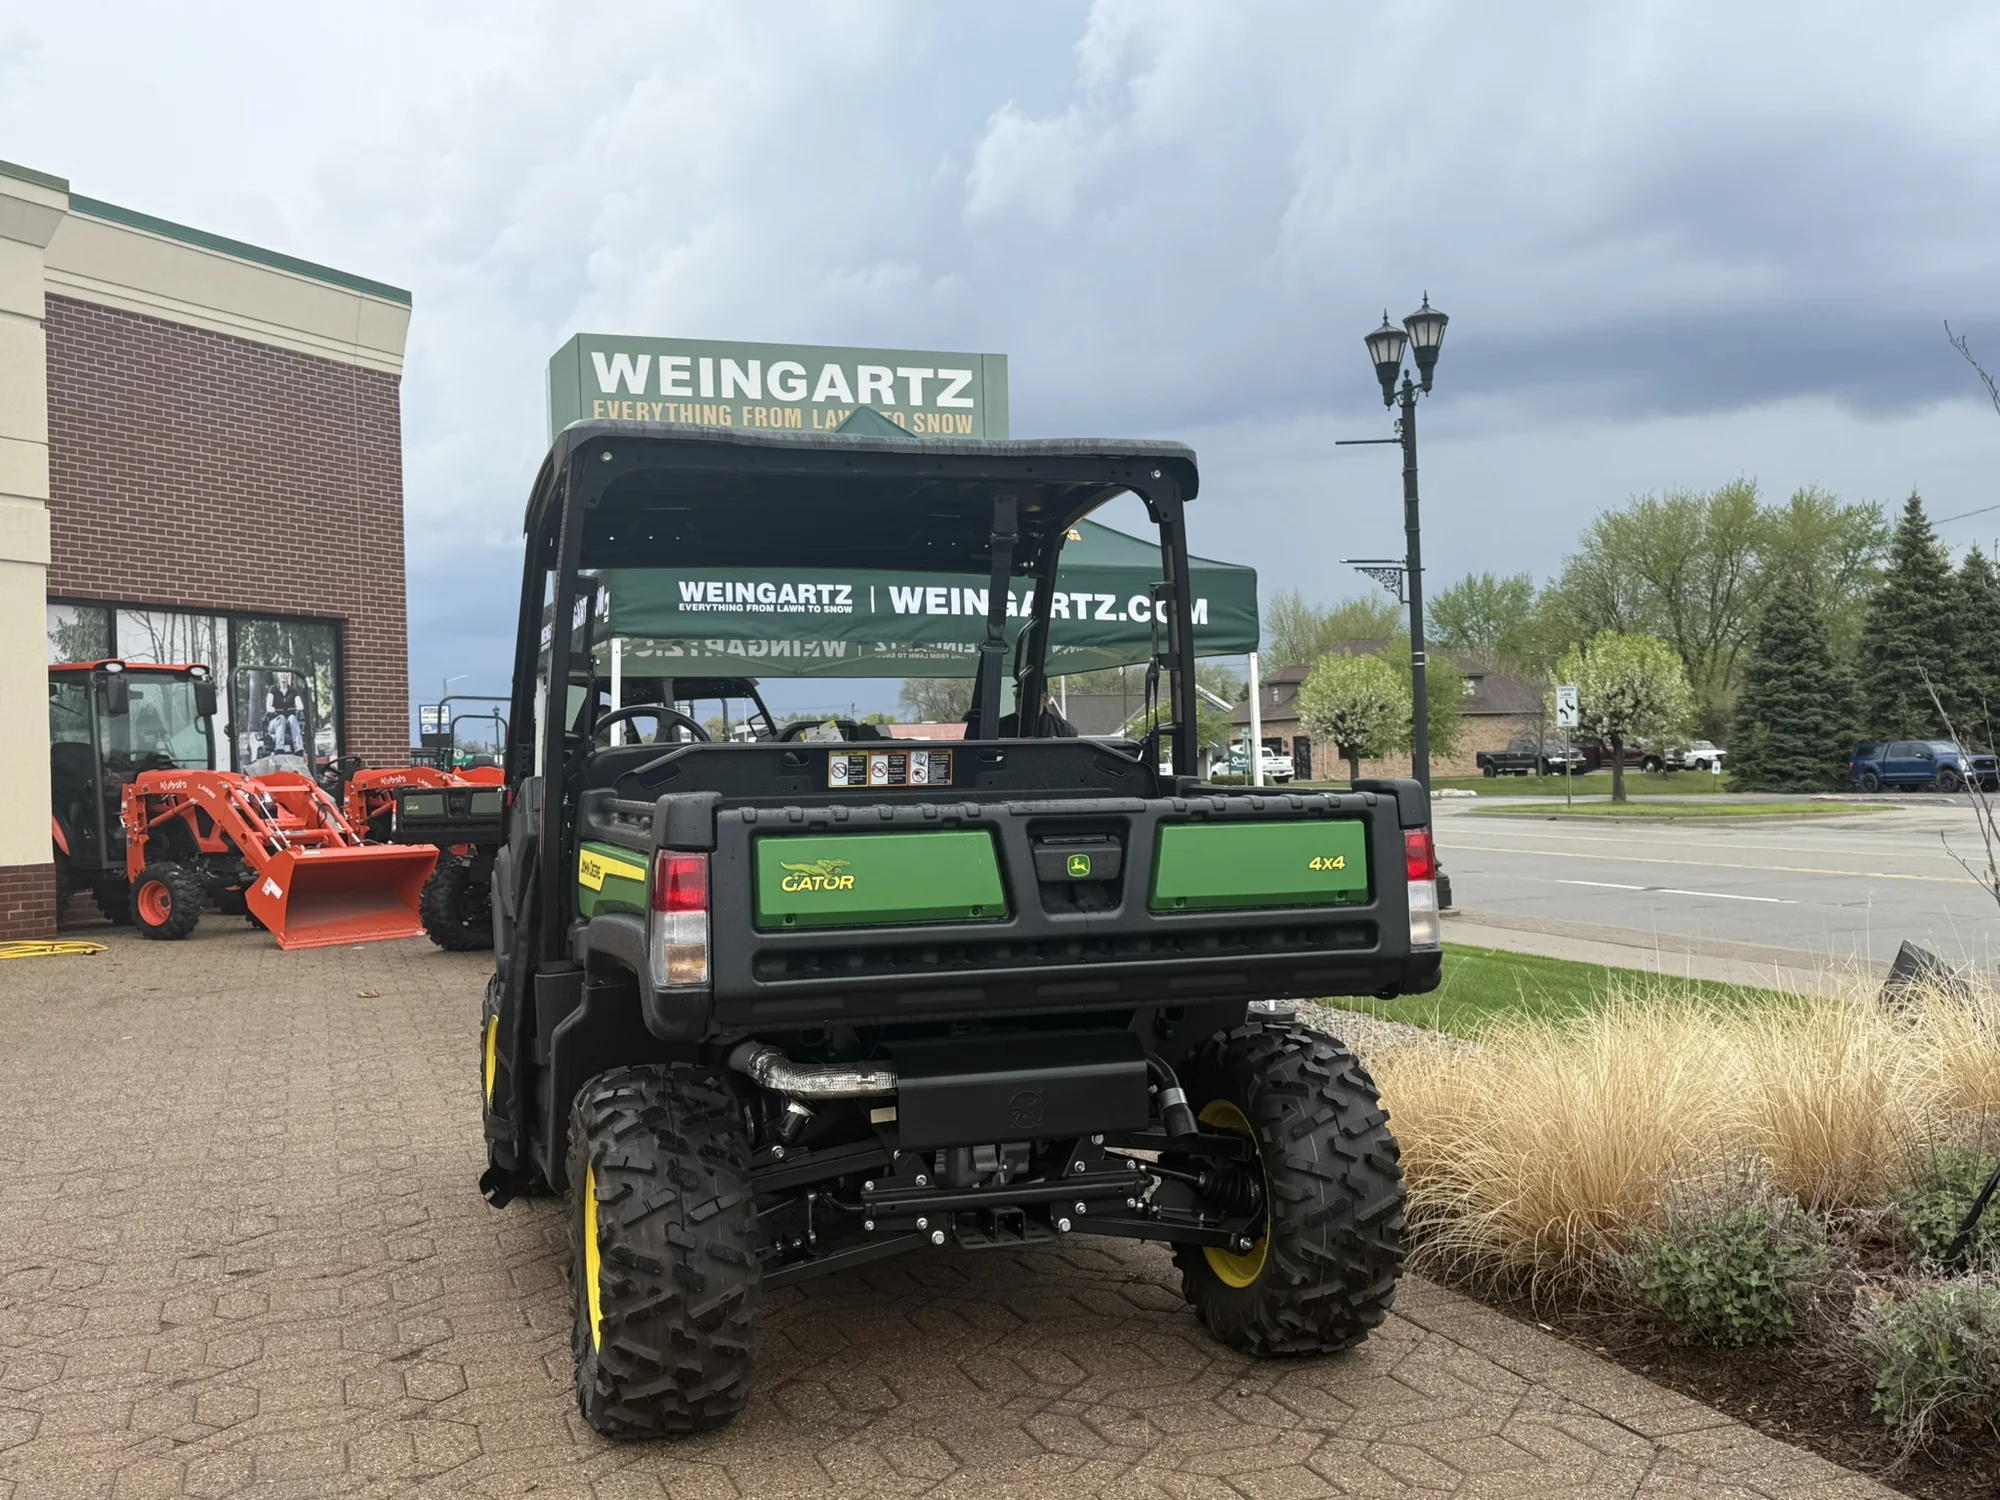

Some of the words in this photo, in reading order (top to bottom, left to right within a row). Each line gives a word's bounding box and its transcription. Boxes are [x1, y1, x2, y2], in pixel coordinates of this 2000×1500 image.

[591, 351, 974, 408] WEINGARTZ
[593, 400, 732, 427] EVERYTHING
[742, 405, 802, 429] FROM
[913, 412, 973, 435] SNOW
[678, 581, 853, 605] WEINGARTZ
[679, 603, 744, 613] EVERYTHING
[746, 604, 775, 612] FROM
[777, 604, 806, 613] LAWN
[808, 605, 822, 613] TO
[824, 605, 853, 613] SNOW
[160, 779, 187, 790] Kubota
[781, 875, 856, 892] GATOR
